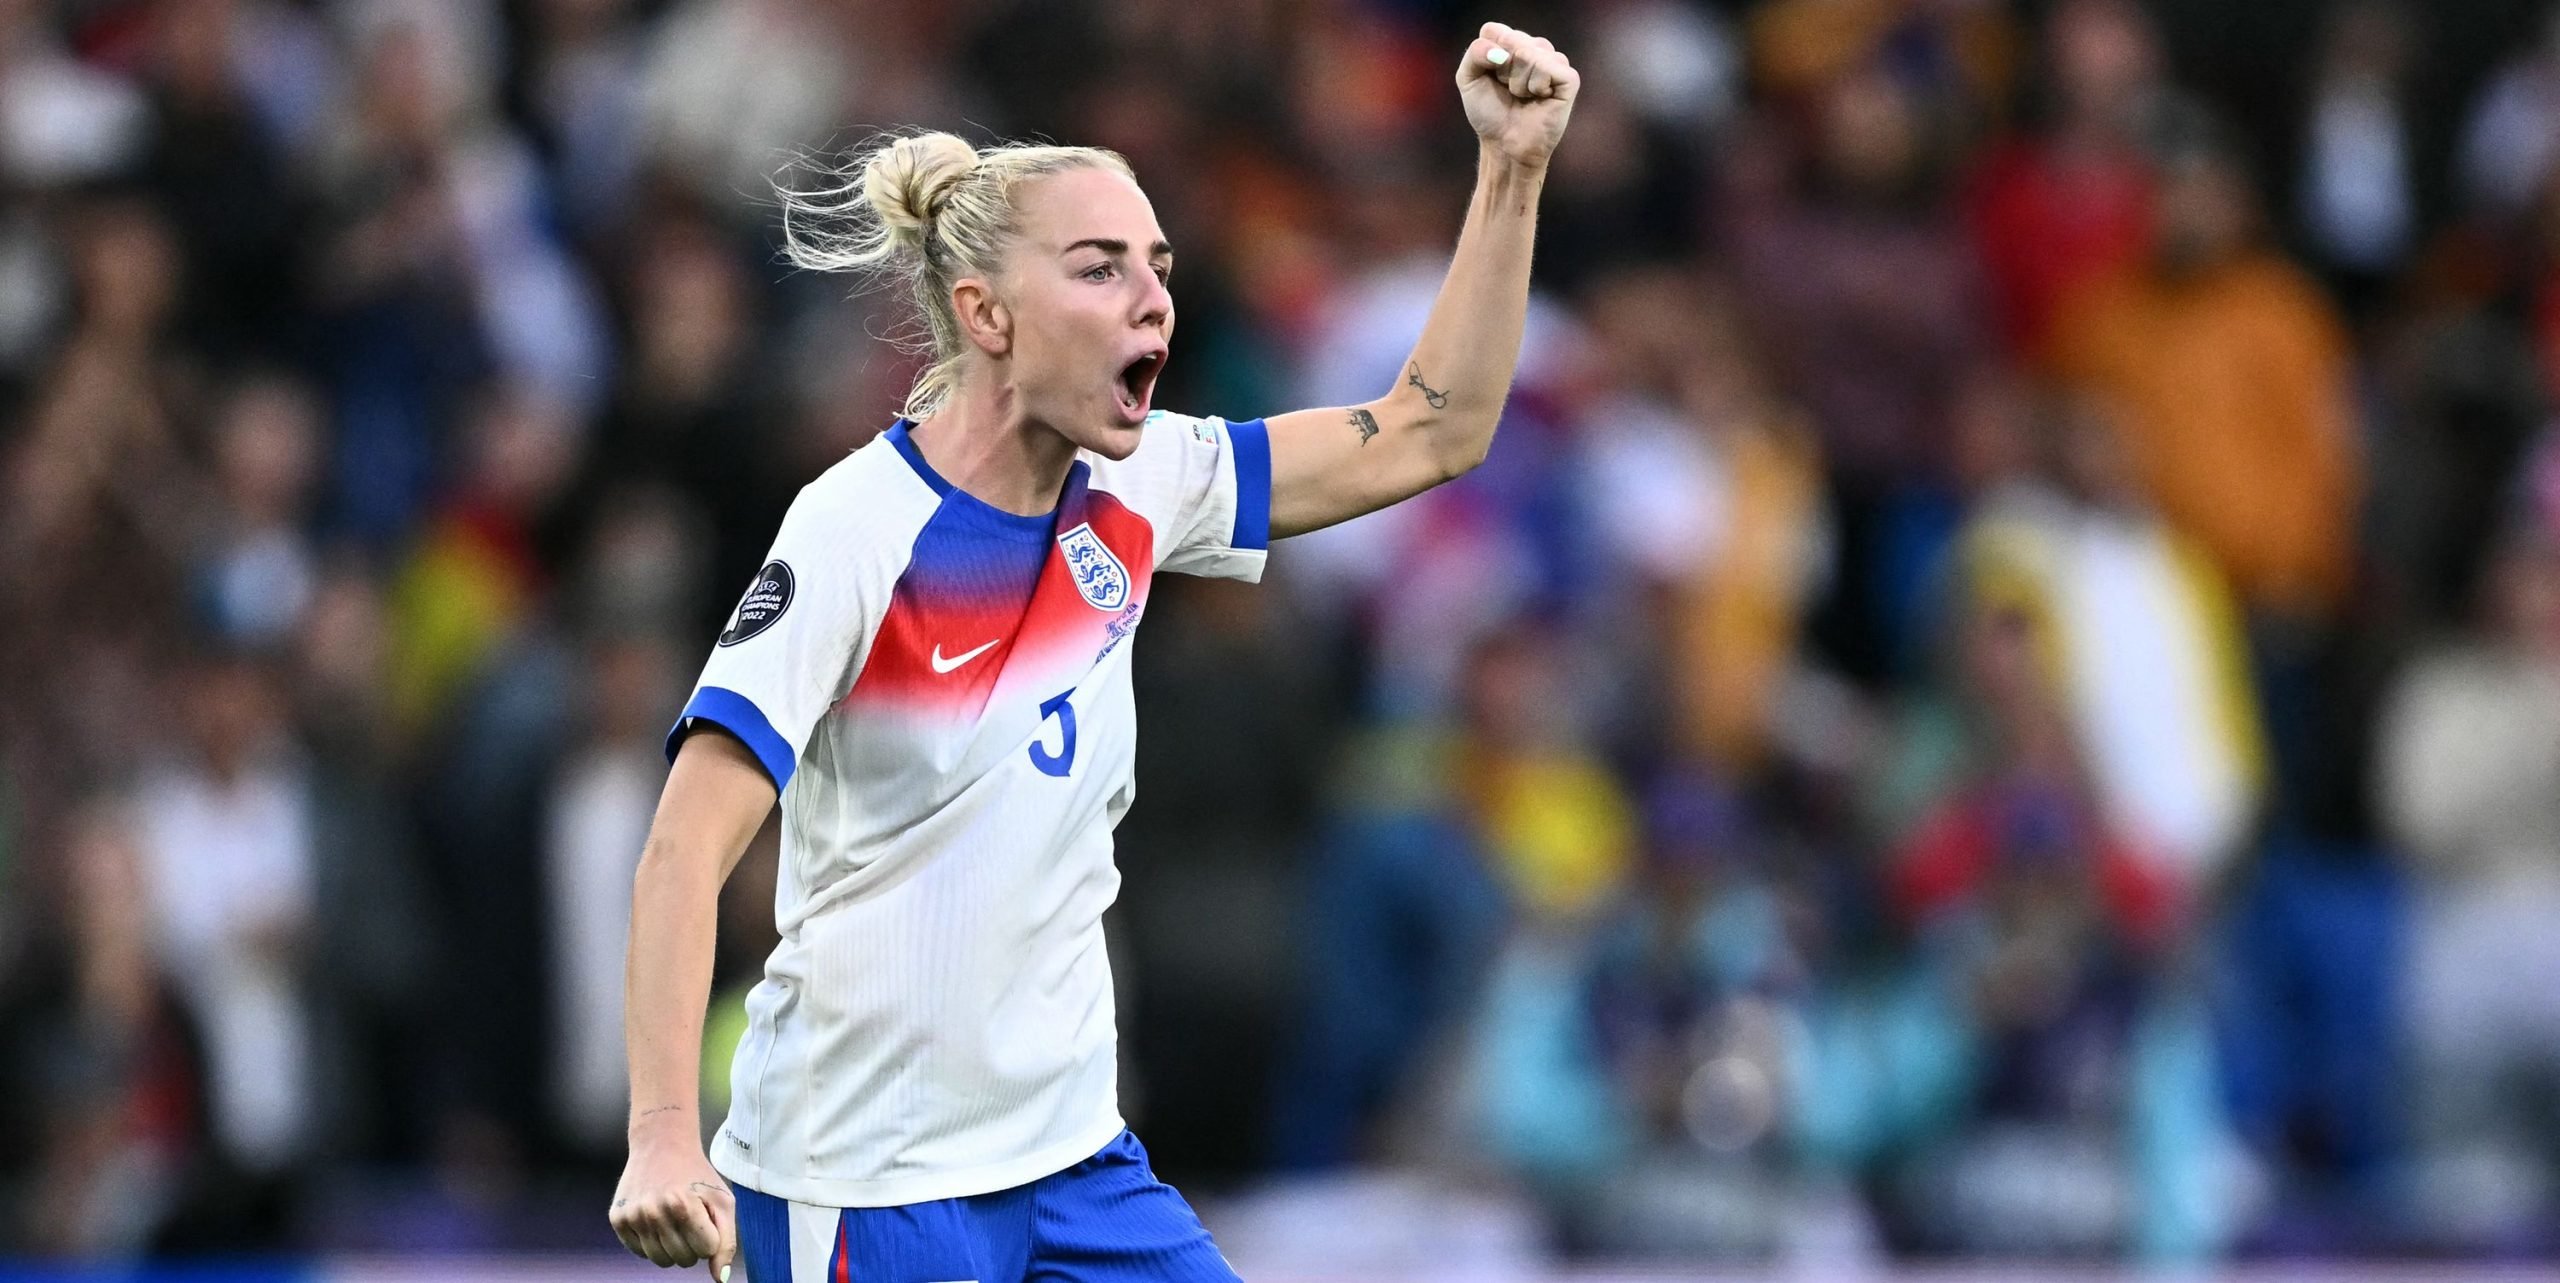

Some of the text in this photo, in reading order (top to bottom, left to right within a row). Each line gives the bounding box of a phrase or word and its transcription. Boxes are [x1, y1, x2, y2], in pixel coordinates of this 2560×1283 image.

[746, 594, 782, 603] EUROPEAN
[741, 602, 780, 611] CHAMPIONS
[742, 611, 766, 620] 2022
